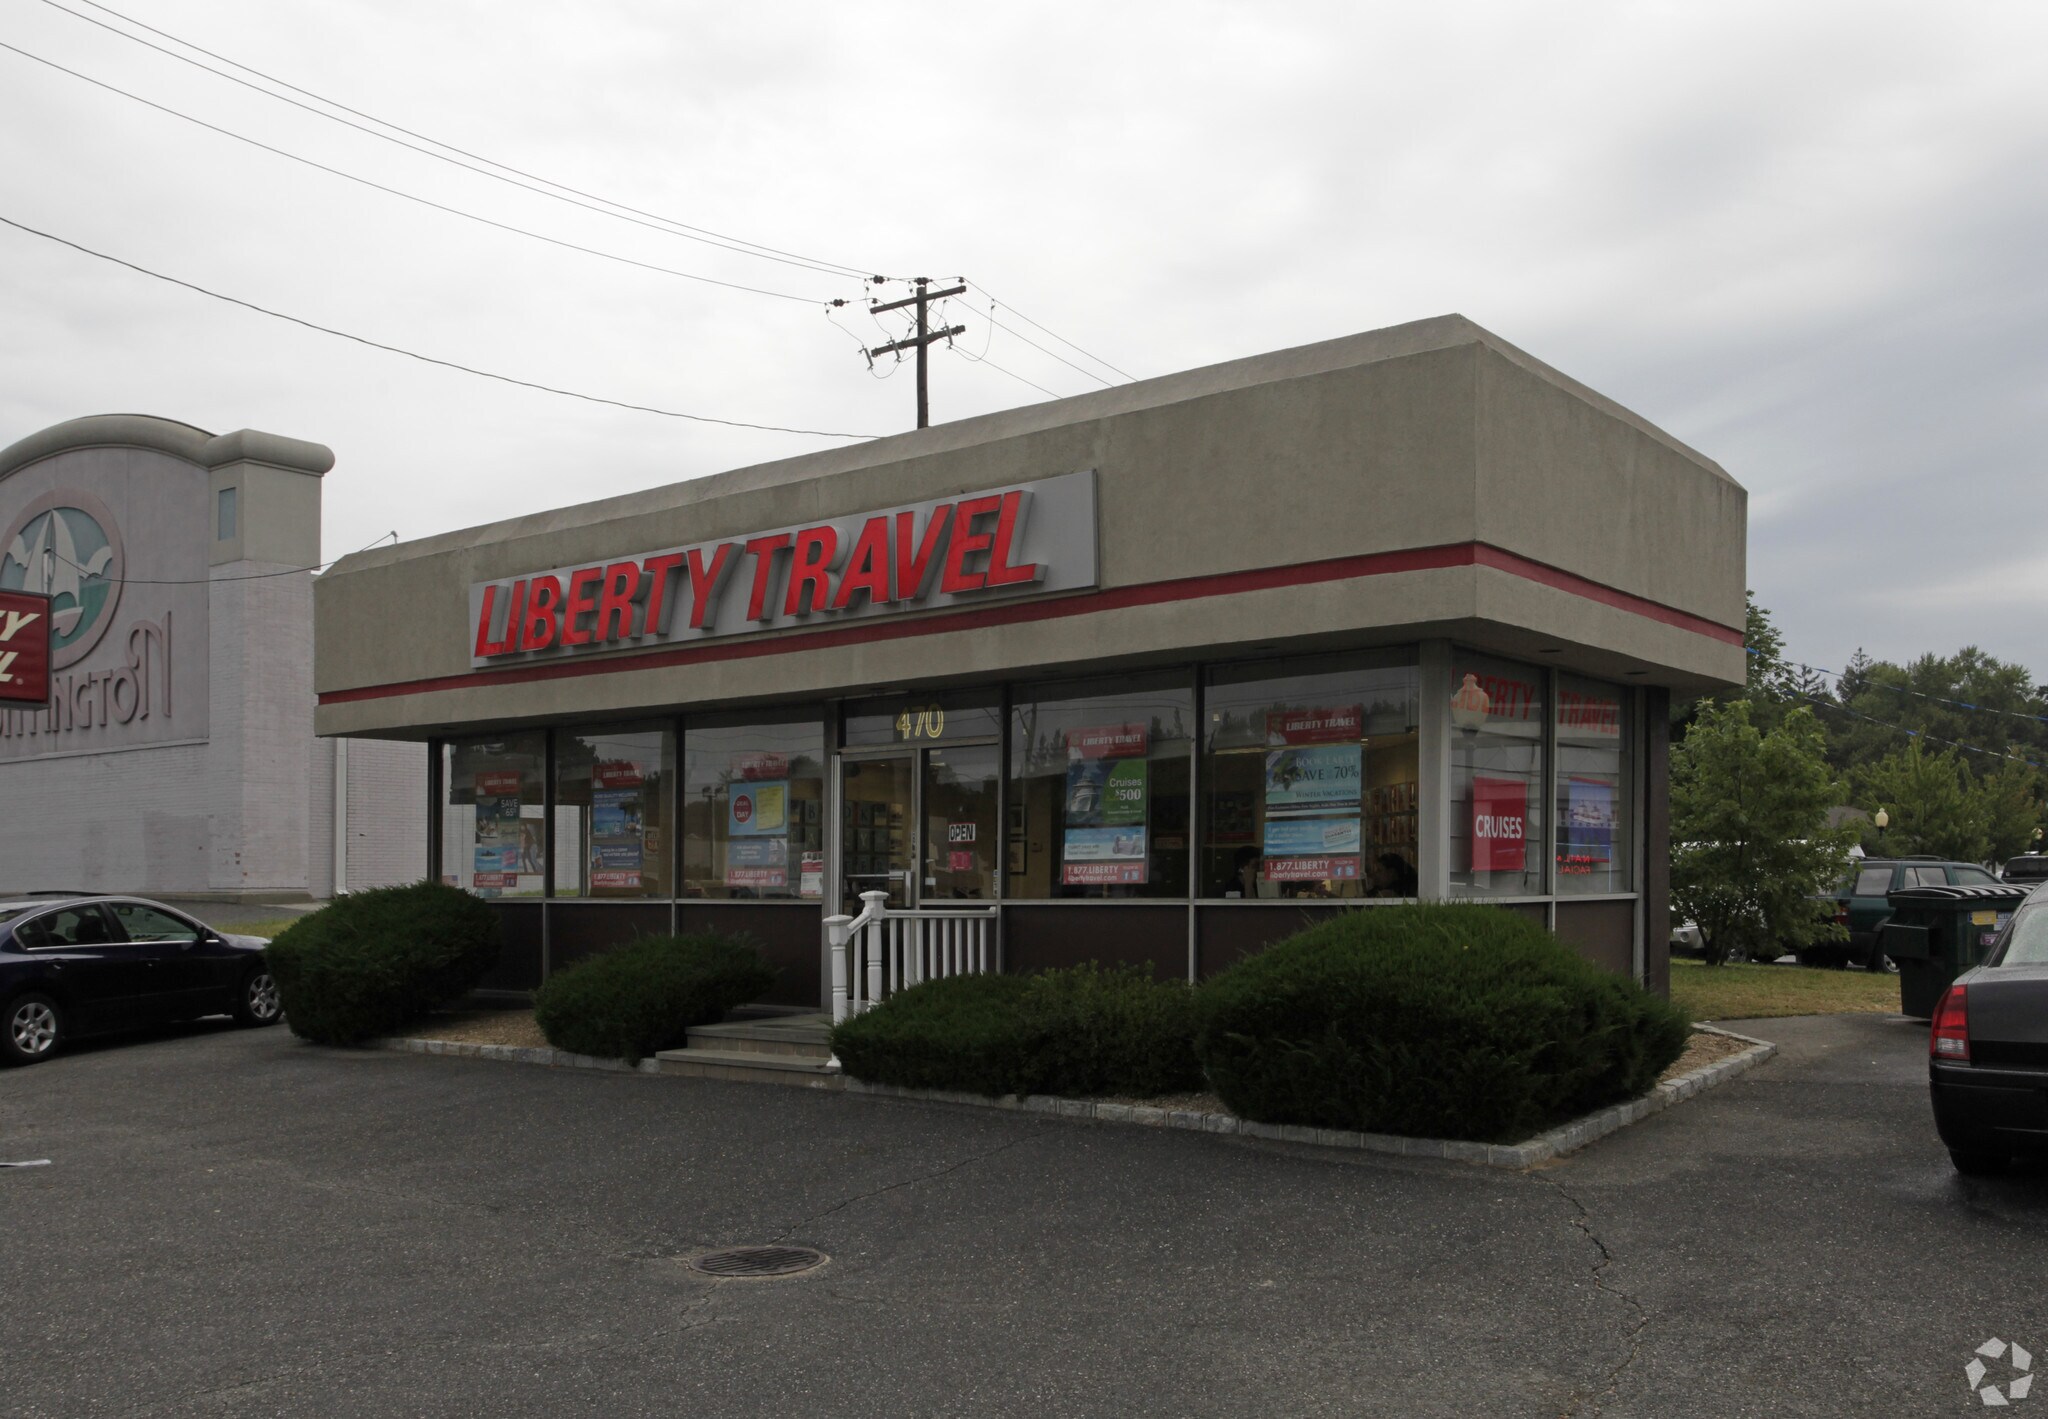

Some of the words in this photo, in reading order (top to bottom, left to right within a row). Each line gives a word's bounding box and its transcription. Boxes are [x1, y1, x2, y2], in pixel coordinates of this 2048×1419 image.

[474, 541, 744, 658] LIBERTY
[746, 489, 1048, 622] TRAVEL
[895, 703, 945, 740] 470
[1286, 720, 1323, 731] LIBERTY
[1325, 717, 1356, 728] TRAVEL
[1083, 736, 1114, 746] LIBERTY
[1115, 734, 1141, 744] TRAVEL
[1296, 756, 1322, 767] BOOK
[1296, 769, 1324, 782] SAVE
[1334, 765, 1359, 779] 70%
[1109, 777, 1142, 788] Cruises
[501, 799, 518, 808] SAVE
[1475, 814, 1522, 839] CRUISES
[950, 824, 973, 841] OPEN
[1068, 865, 1119, 875] 1.877.LIBERTY
[1269, 860, 1330, 871] 1.877.LIBERTY
[1068, 874, 1118, 884] libertytravel.com
[1269, 870, 1328, 880] libertytravel.com
